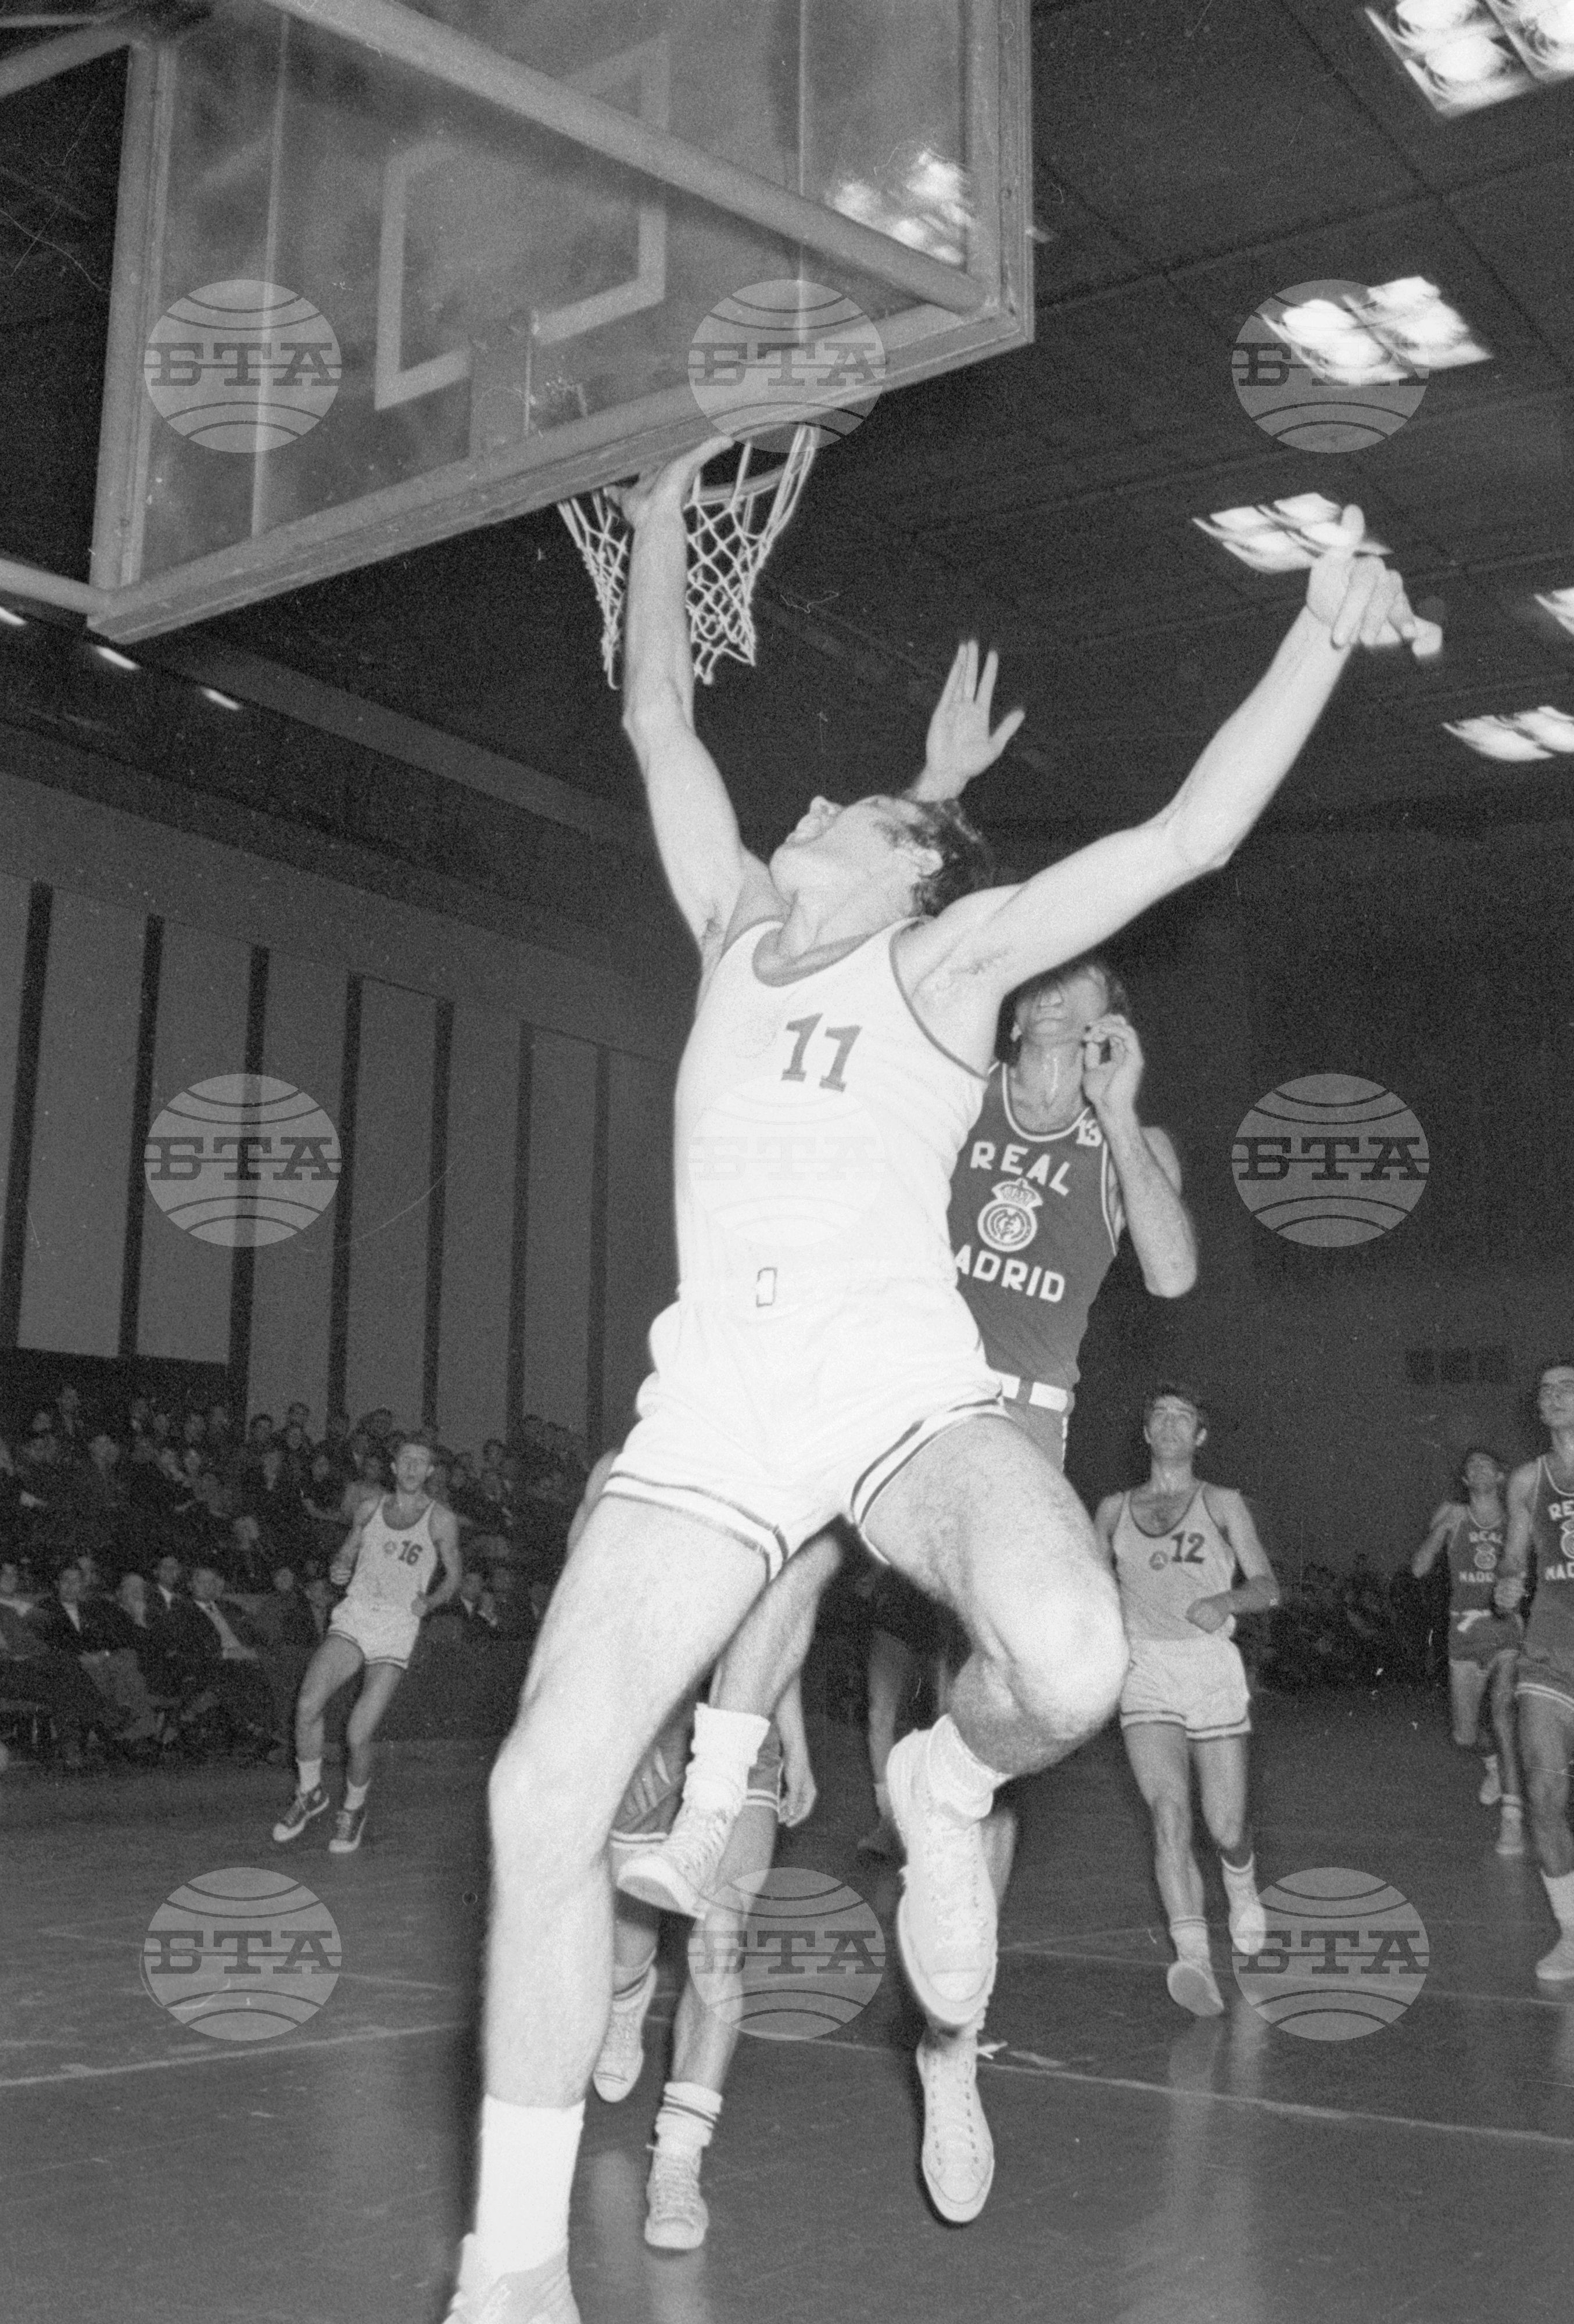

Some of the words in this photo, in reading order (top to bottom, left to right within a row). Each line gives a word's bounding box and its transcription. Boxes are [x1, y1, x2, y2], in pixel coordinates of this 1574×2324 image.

[781, 1013, 862, 1092] 11
[970, 1141, 1070, 1196] REAL
[955, 1245, 1066, 1302] ADRID
[1548, 1500, 1574, 1520] RE
[398, 1540, 423, 1566] 16
[1171, 1530, 1205, 1564] 12
